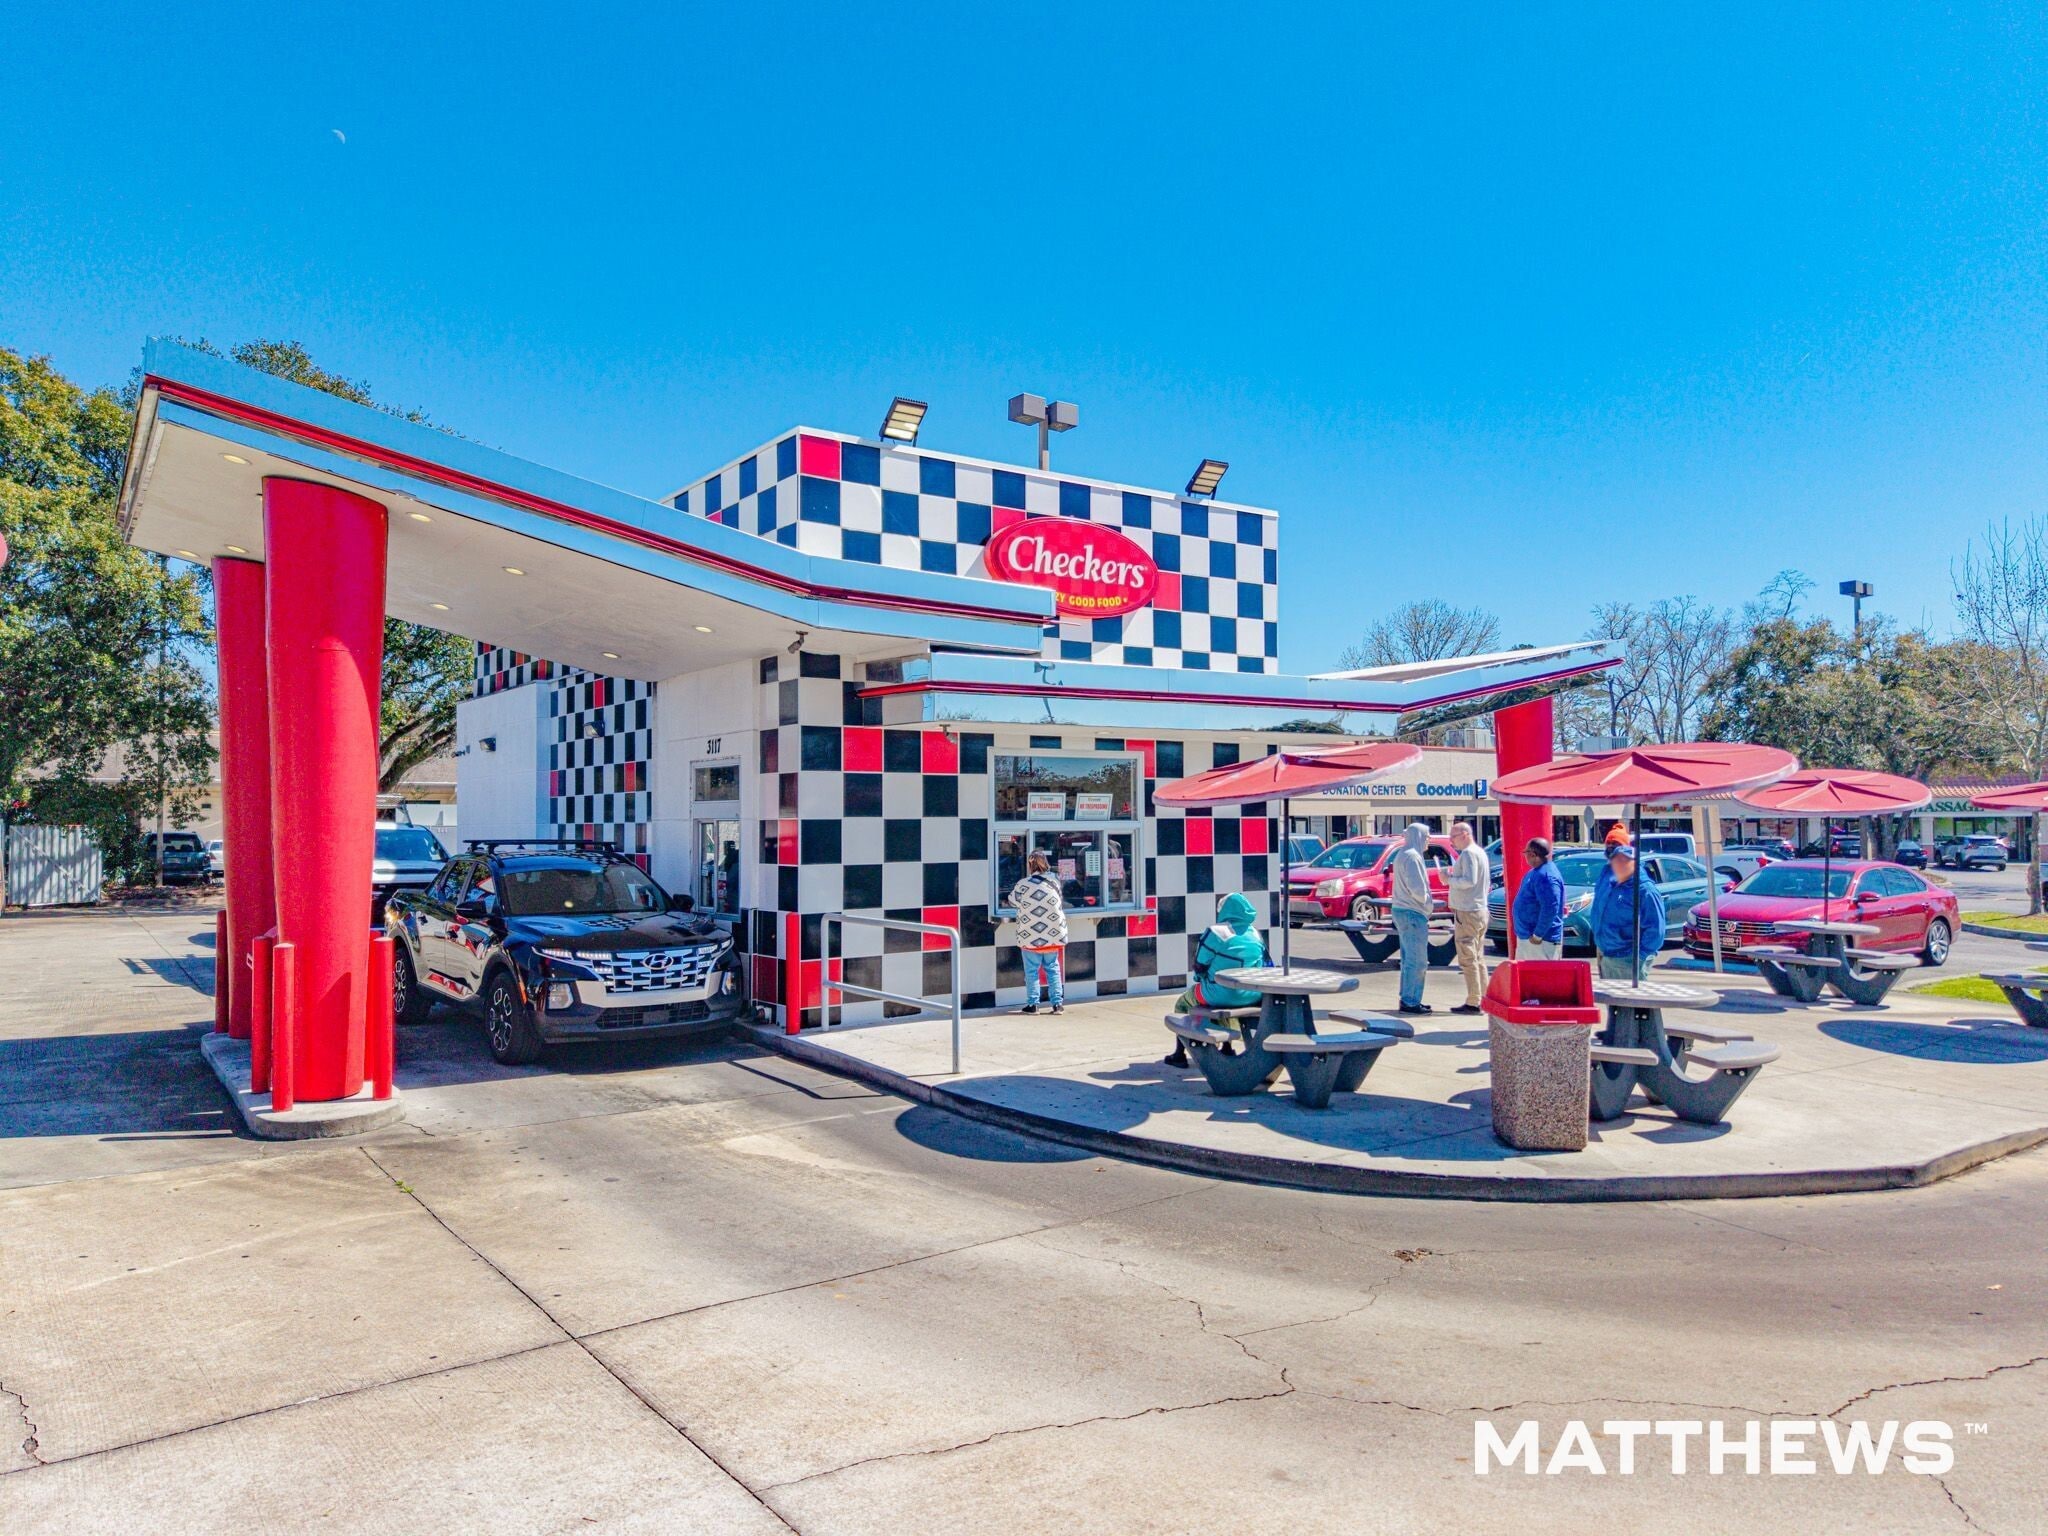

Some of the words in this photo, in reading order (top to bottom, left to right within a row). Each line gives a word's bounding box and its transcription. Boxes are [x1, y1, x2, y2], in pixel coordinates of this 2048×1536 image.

[1008, 536, 1145, 588] Checkers
[1069, 595, 1095, 608] GOOD
[1097, 596, 1121, 608] FOOD
[707, 738, 721, 754] 3117
[1372, 784, 1407, 796] CENTER
[1416, 782, 1474, 796] Goodwill
